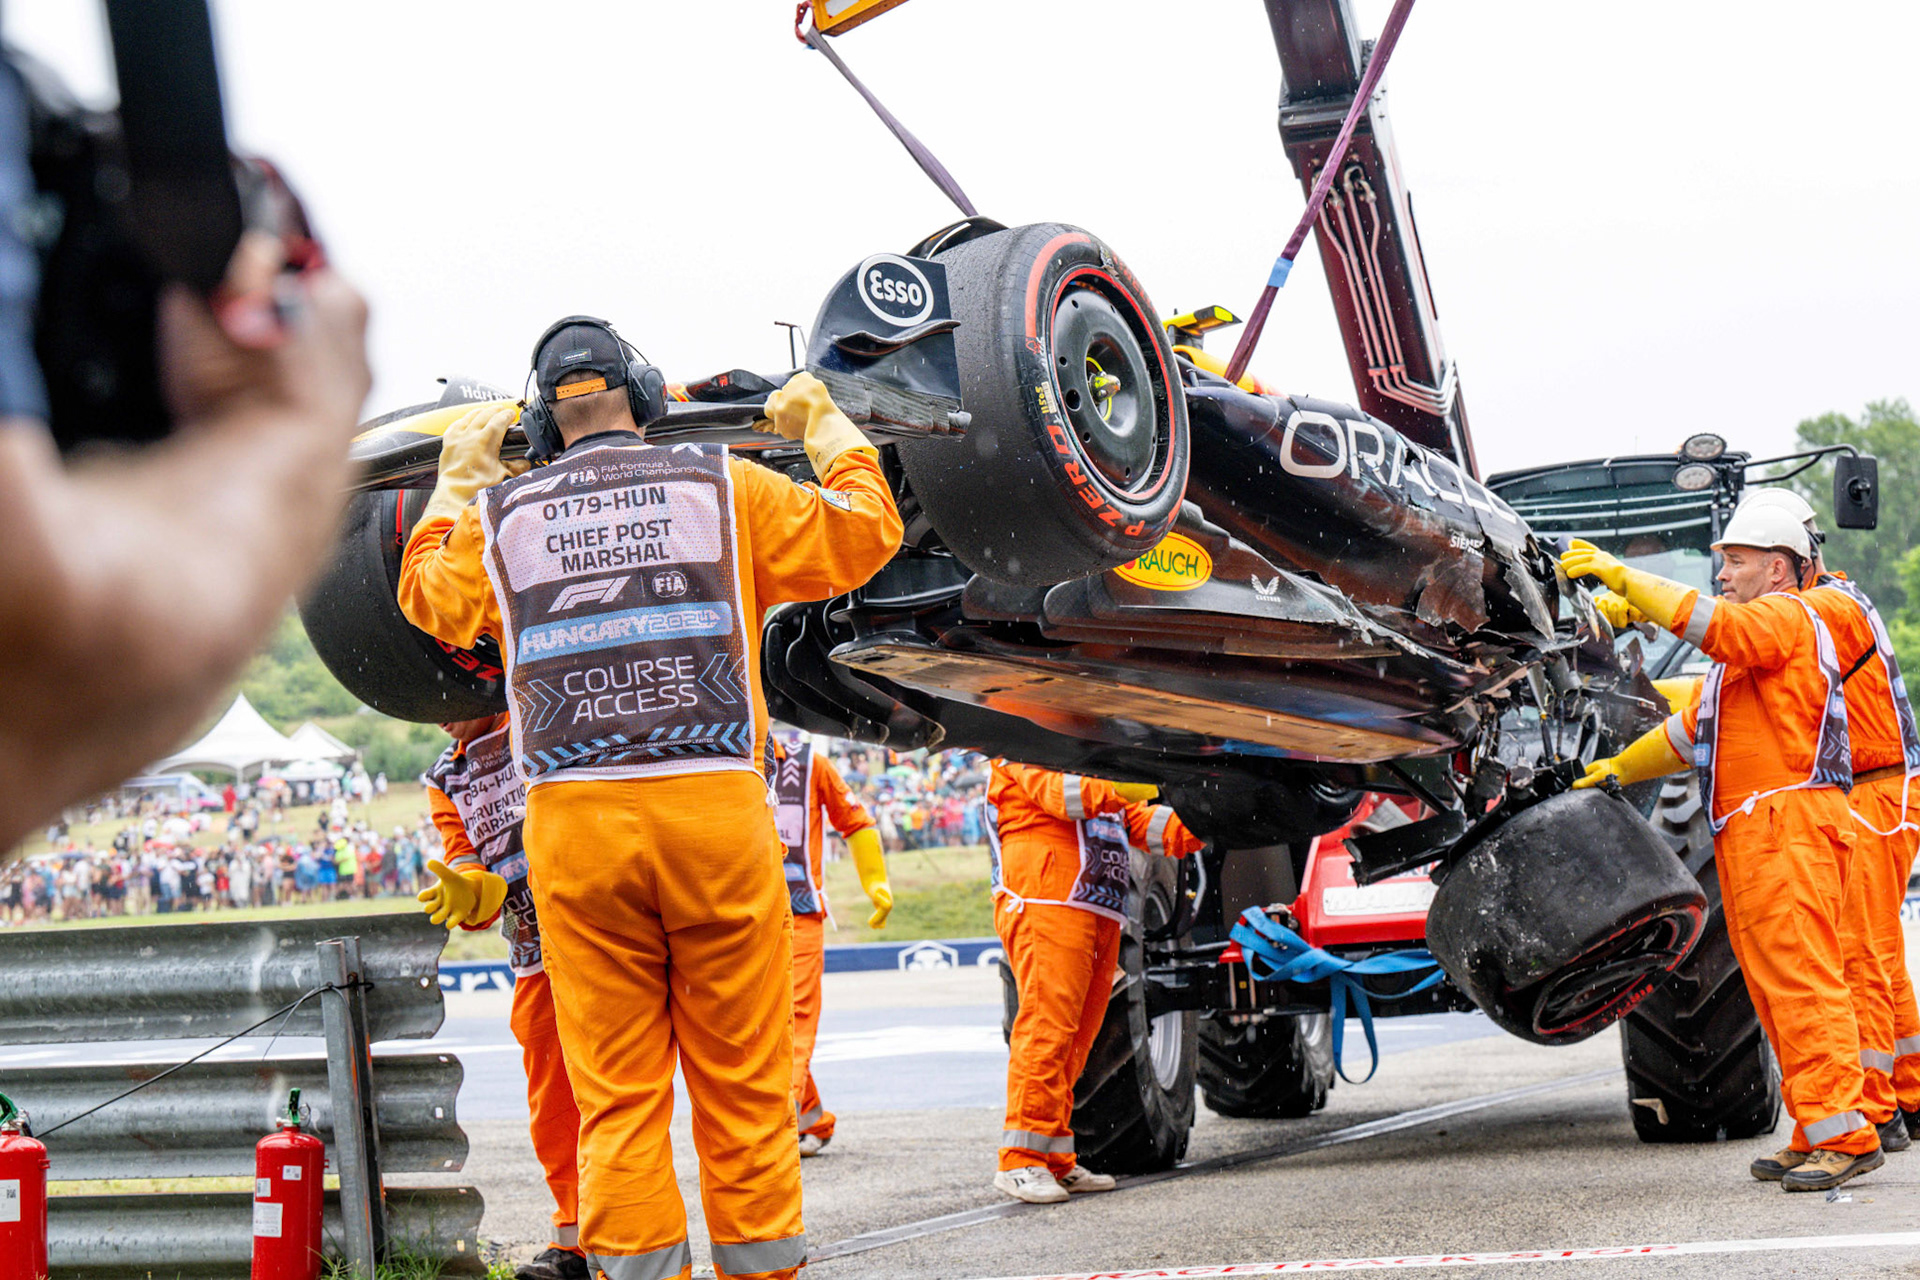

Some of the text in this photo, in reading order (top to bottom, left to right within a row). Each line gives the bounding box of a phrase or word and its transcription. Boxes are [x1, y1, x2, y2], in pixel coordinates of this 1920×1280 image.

[601, 465, 619, 474] FIA
[620, 461, 664, 470] Formula
[601, 465, 708, 481] World Championship
[1046, 425, 1146, 536] P ZERO
[542, 486, 667, 521] 0179-HUN
[546, 518, 673, 554] CHIEF POST
[561, 541, 670, 574] MARSHAL
[1138, 549, 1199, 578] RAUCH
[563, 655, 695, 696] COURSE
[572, 683, 699, 725] ACCESS
